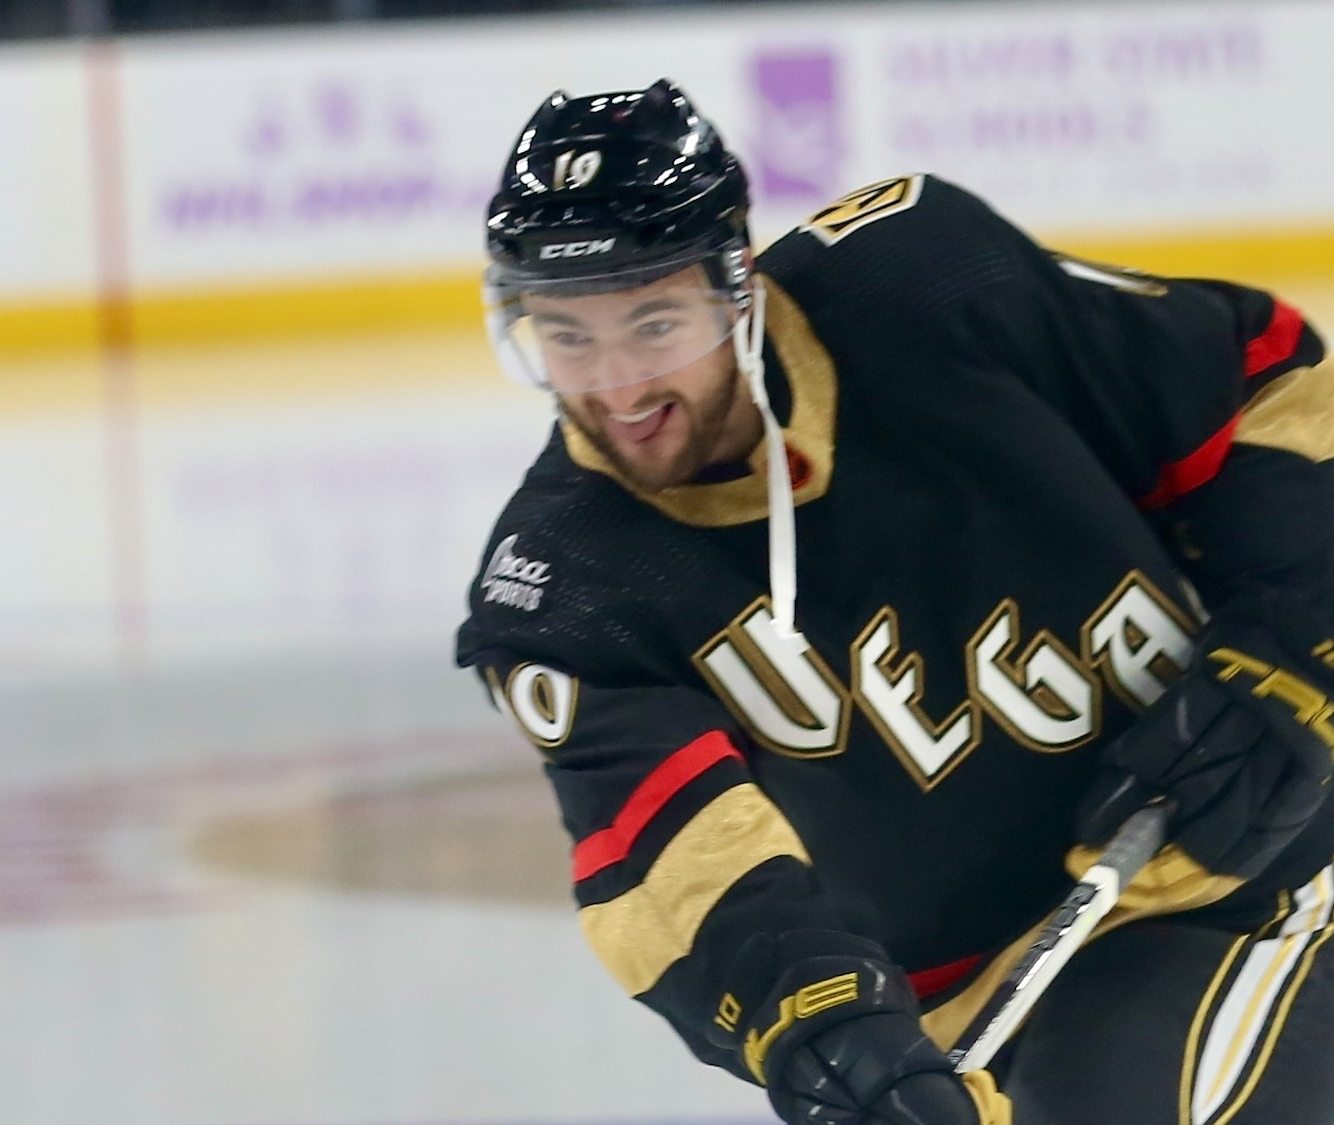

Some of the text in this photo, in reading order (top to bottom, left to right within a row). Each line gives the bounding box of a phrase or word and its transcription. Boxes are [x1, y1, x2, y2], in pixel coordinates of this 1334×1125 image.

[539, 238, 617, 260] CCM
[691, 570, 1212, 793] VEGA
[714, 992, 743, 1033] 10
